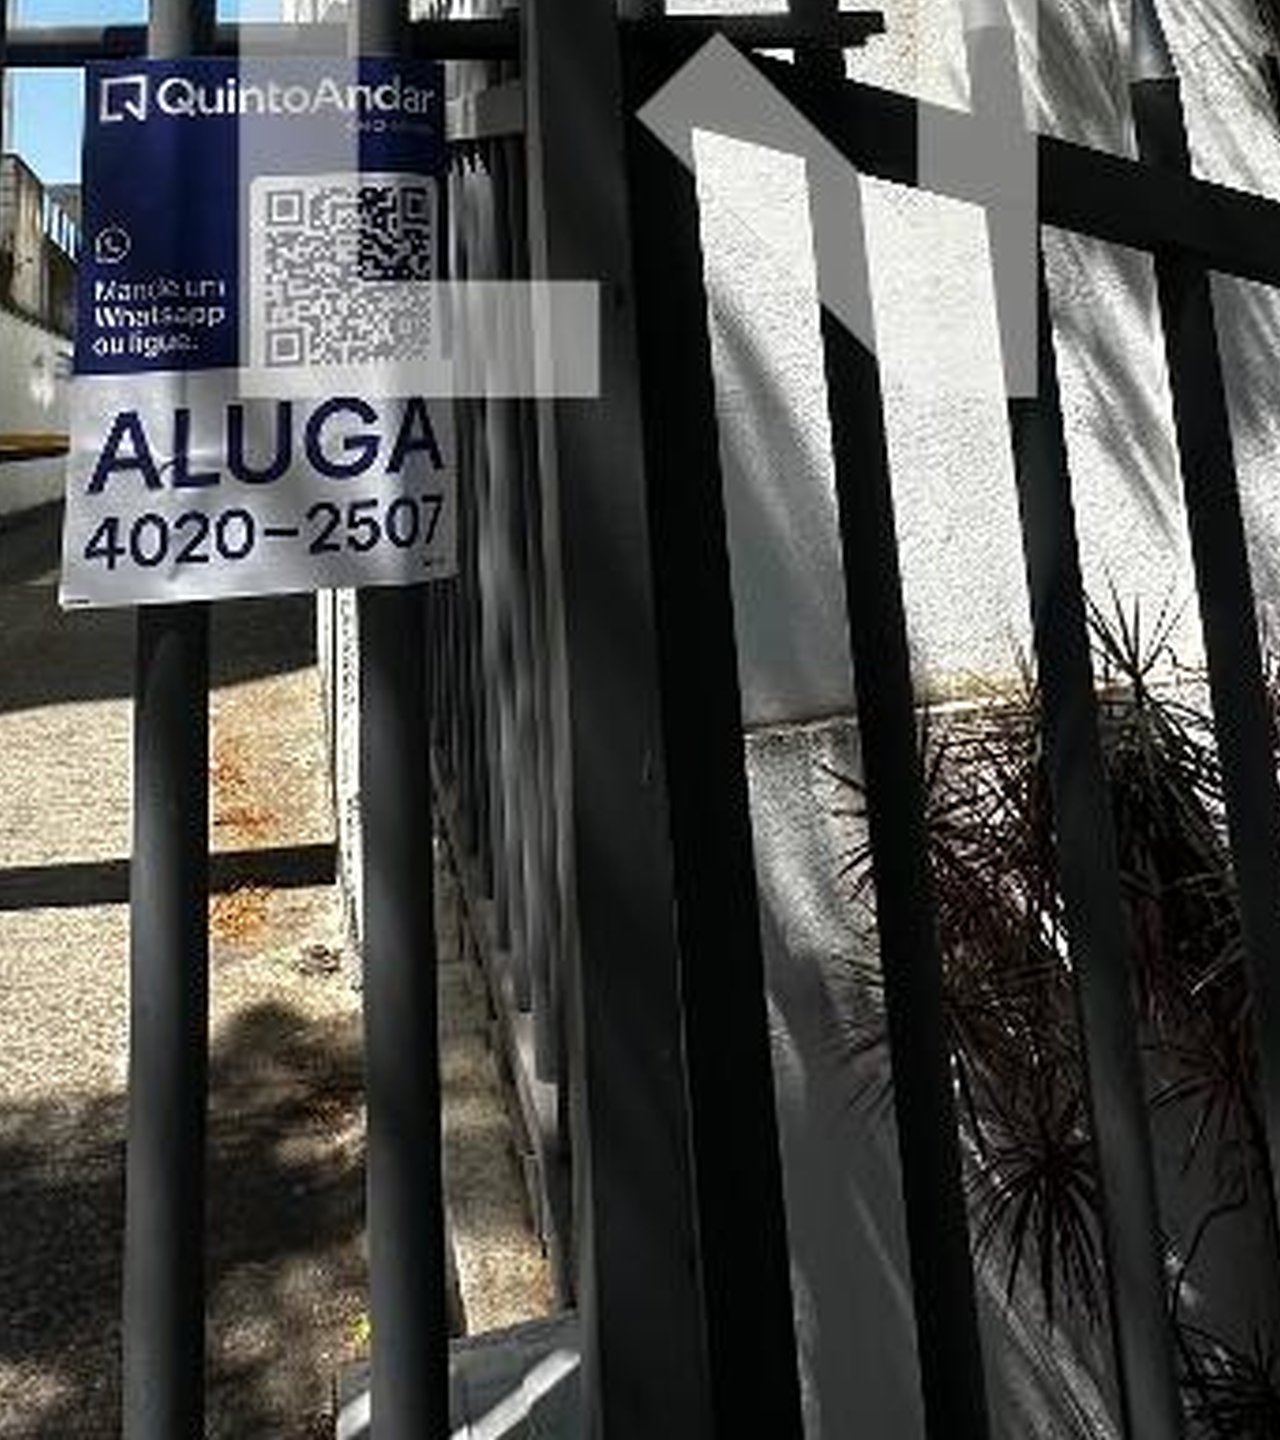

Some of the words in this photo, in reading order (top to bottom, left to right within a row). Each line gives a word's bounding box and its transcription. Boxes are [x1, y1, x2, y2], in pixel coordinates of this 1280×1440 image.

[157, 73, 435, 117] QuintoAndar
[94, 279, 179, 301] Mande
[94, 305, 226, 328] Whatsapp
[92, 336, 124, 356] ou
[87, 396, 444, 494] ALUGA
[84, 495, 442, 569] 4020-2507
